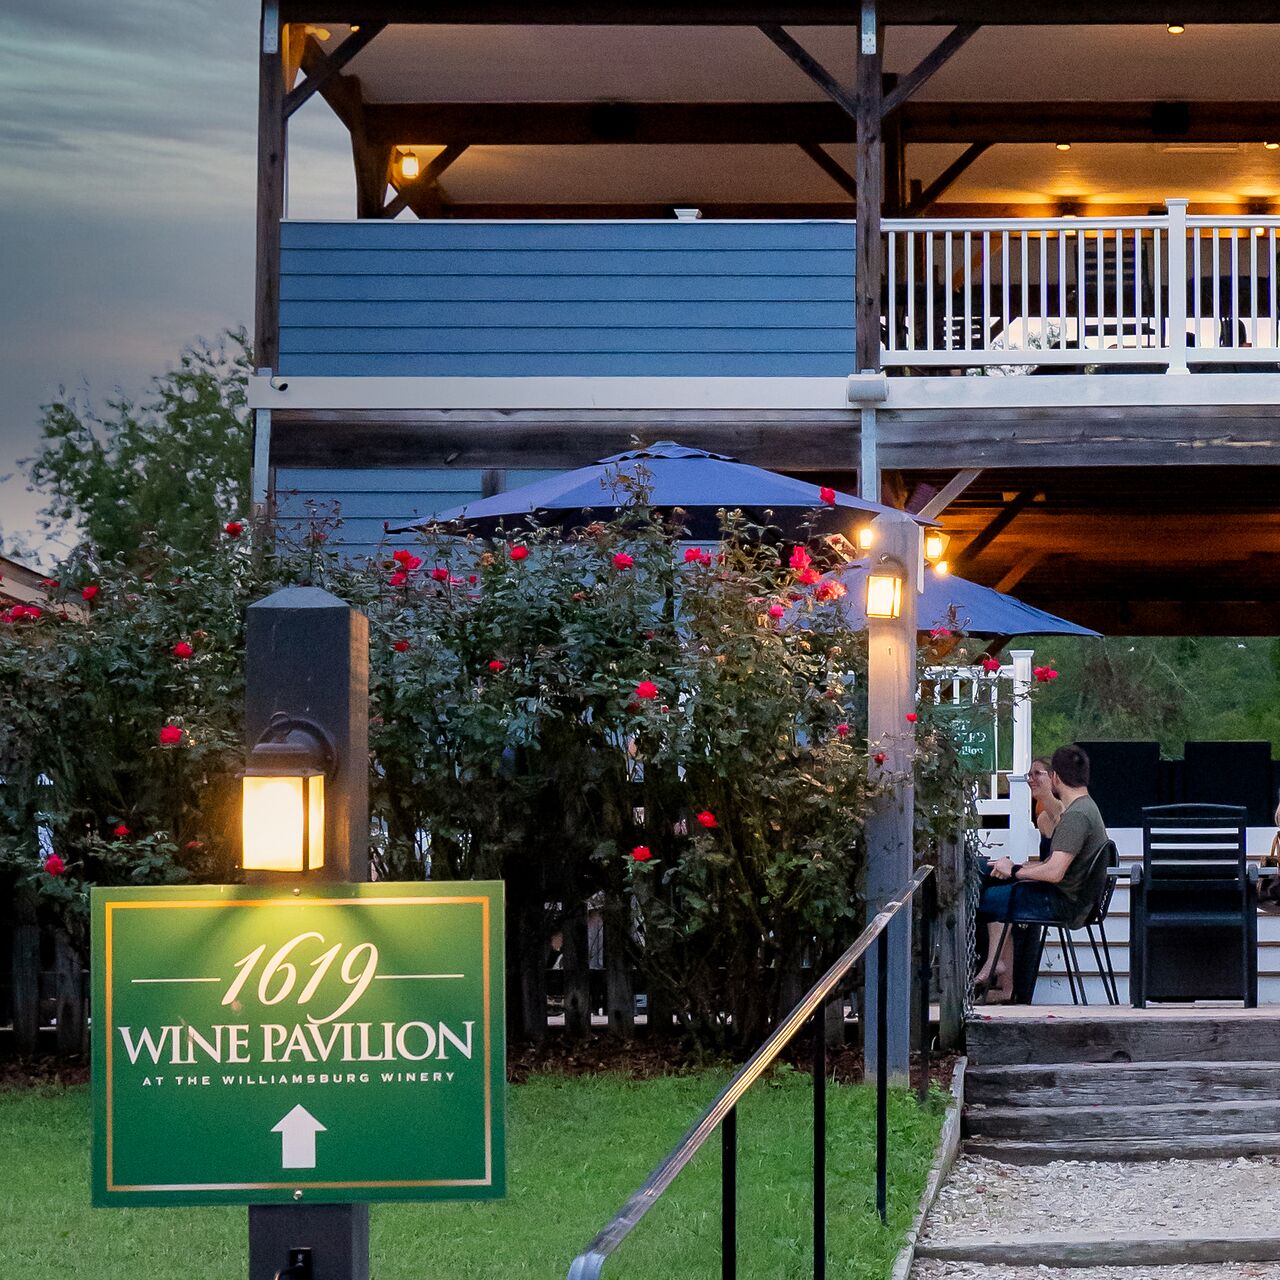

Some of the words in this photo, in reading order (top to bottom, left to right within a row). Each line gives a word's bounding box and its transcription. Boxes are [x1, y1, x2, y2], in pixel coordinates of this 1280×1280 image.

[221, 931, 379, 1024] 1619
[117, 1024, 251, 1065] WINE
[260, 1021, 475, 1063] PAVILION
[142, 1076, 164, 1086] AT
[175, 1076, 211, 1086] THE
[222, 1073, 370, 1085] WILLIAMSBURG
[380, 1072, 455, 1083] WINERY
